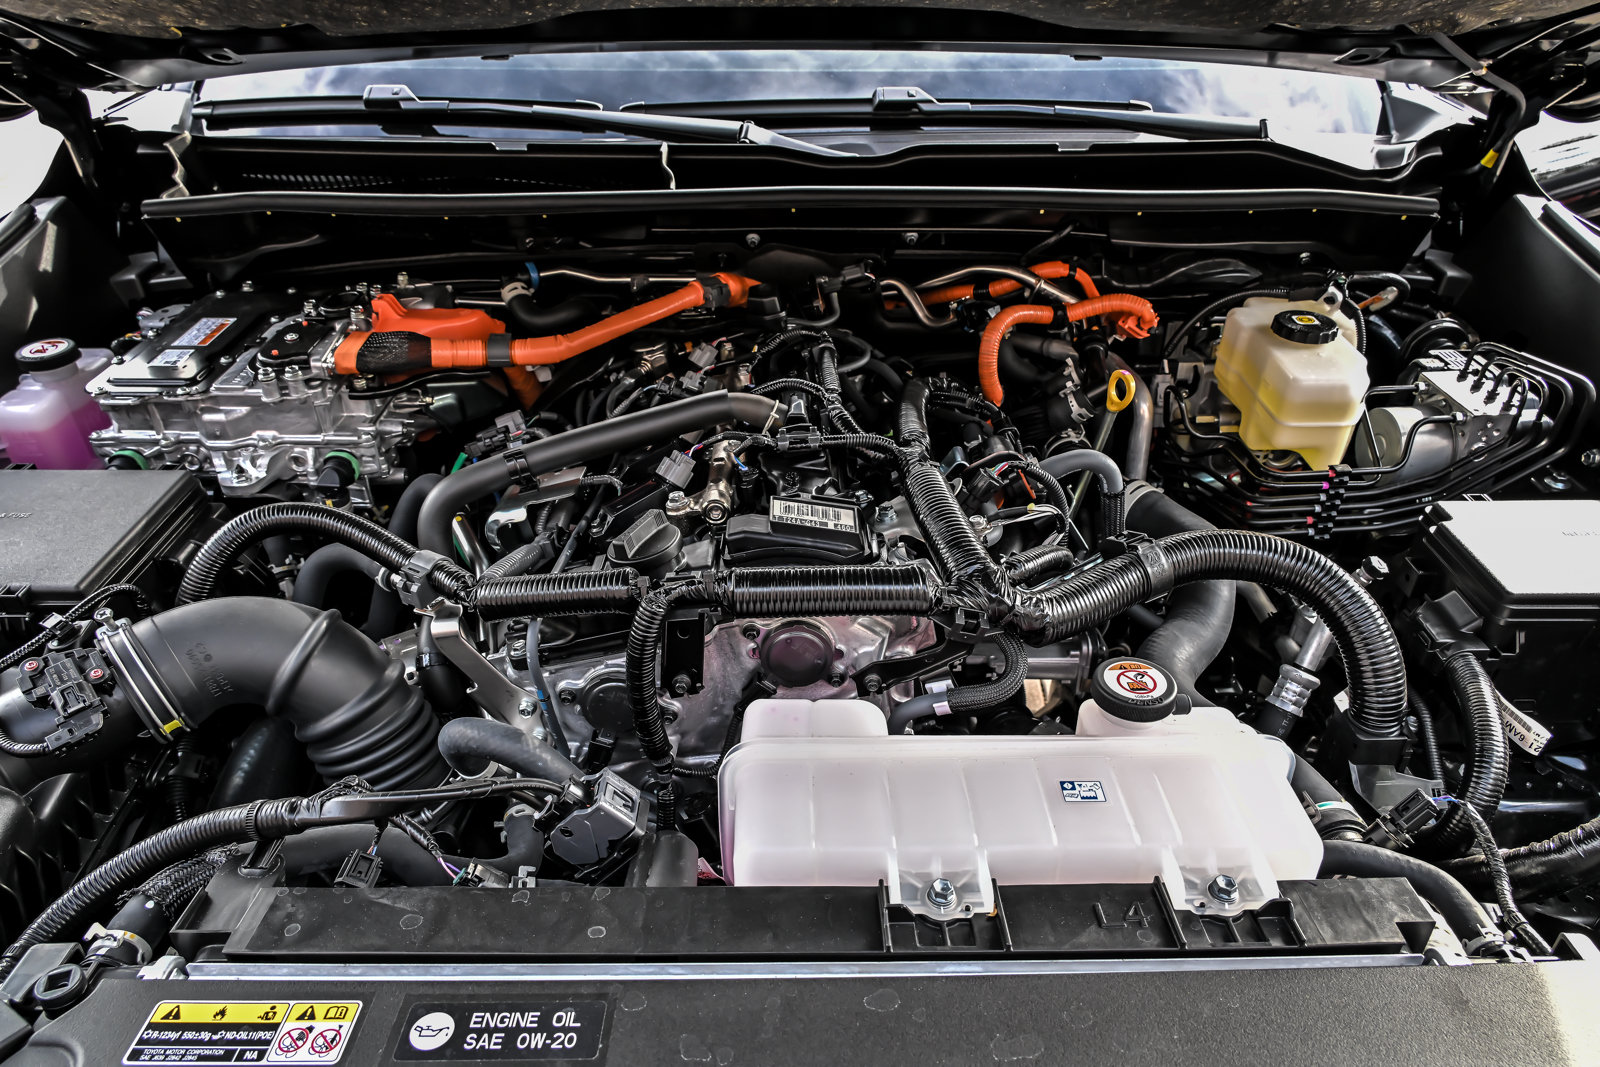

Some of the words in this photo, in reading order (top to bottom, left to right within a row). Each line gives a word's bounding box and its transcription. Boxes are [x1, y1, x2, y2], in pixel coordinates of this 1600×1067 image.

[1128, 697, 1165, 706] DENSO
[1092, 901, 1150, 929] L4
[469, 1011, 540, 1028] ENGINE
[552, 1011, 582, 1028] OIL
[463, 1033, 504, 1050] SAE
[516, 1033, 577, 1050] 0W-20
[243, 1050, 258, 1060] NA
